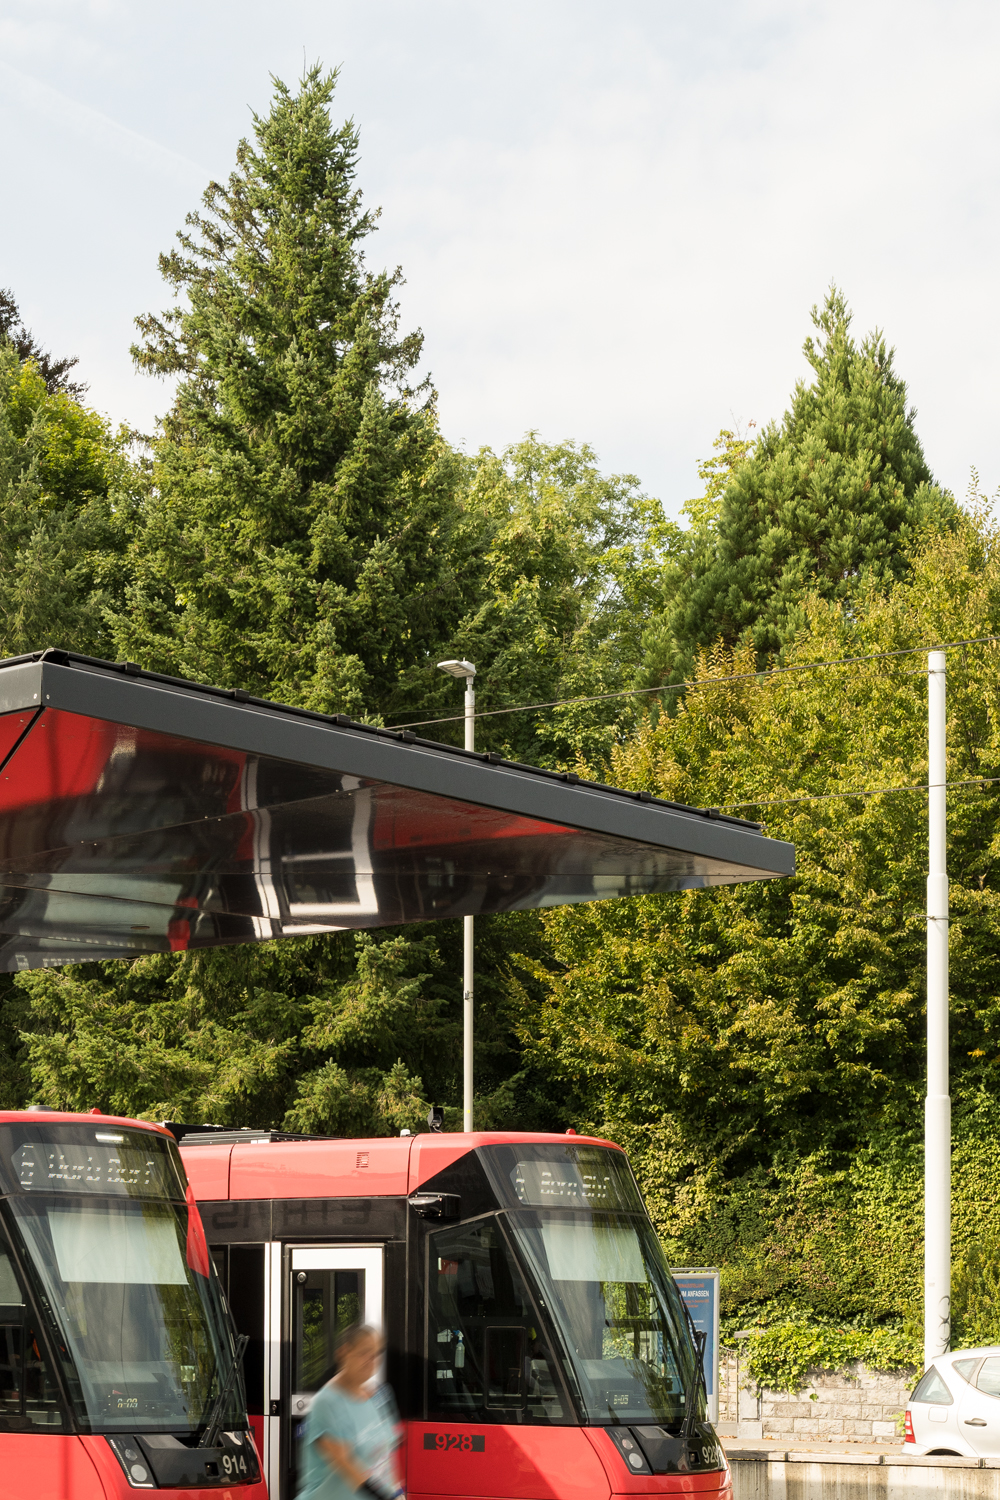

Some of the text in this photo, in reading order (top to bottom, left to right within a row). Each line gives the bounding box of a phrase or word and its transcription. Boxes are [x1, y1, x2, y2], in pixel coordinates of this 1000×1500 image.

[687, 1290, 710, 1298] ANFASSEN
[434, 1432, 474, 1451] 928
[222, 1454, 248, 1475] 914
